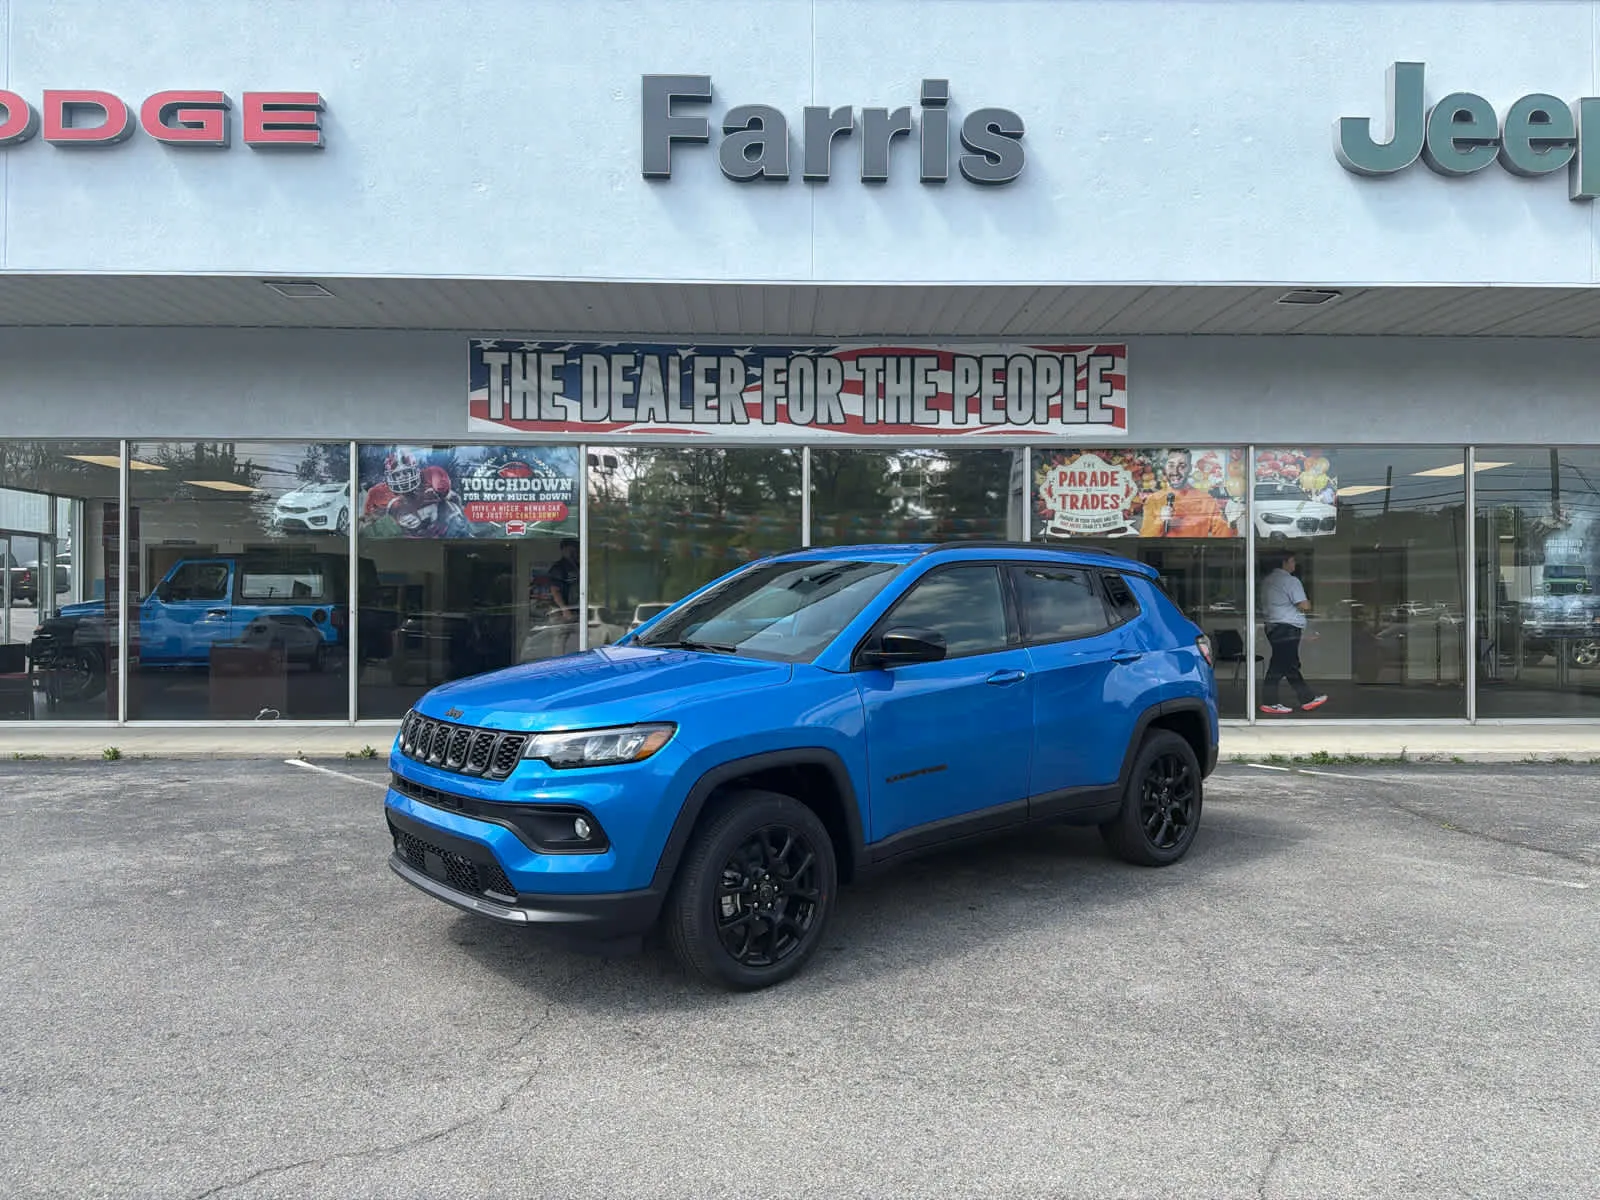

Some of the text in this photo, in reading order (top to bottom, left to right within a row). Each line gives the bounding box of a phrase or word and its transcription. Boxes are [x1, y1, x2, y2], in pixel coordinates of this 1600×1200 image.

[641, 74, 1026, 185] Farris
[1333, 61, 1600, 201] Jee
[482, 350, 1115, 426] THE DEALER FOR THE PEOPLE
[461, 478, 573, 492] TOUCHDOWN
[1058, 471, 1120, 487] PARADE
[463, 493, 572, 501] FOR NOT MUCH DOWN!
[1058, 494, 1120, 510] TRADES
